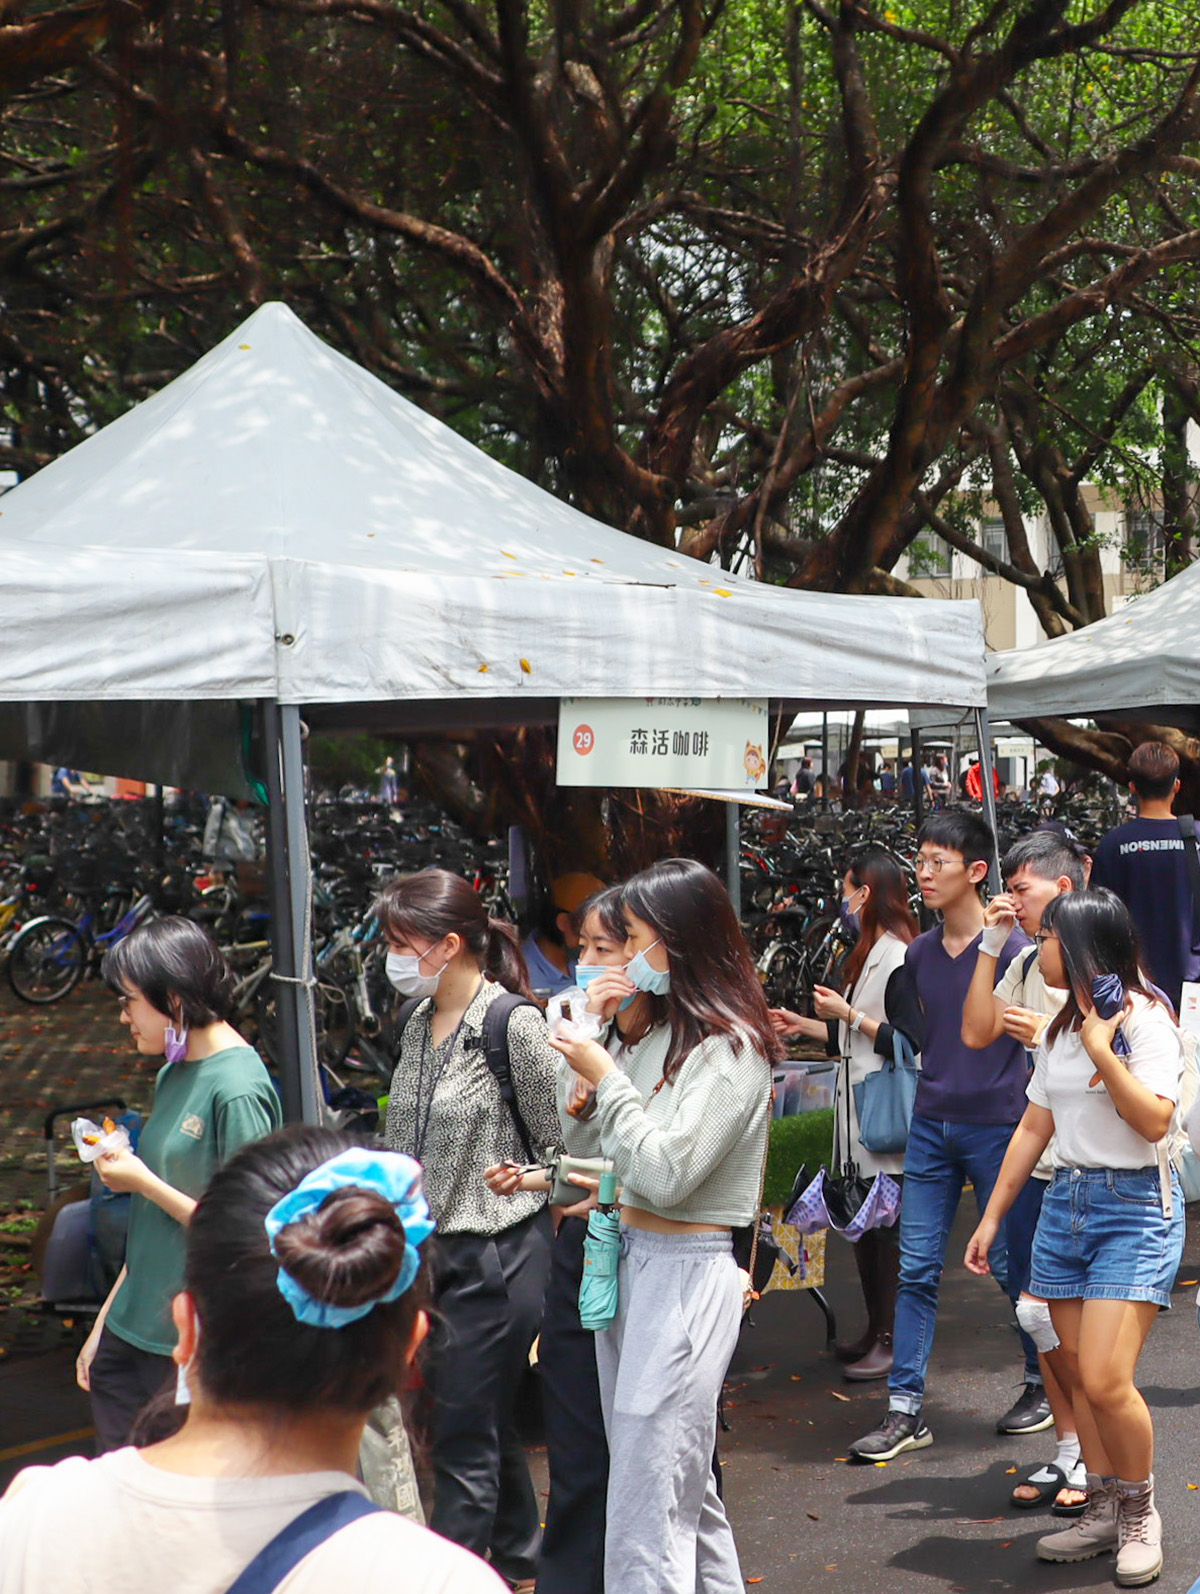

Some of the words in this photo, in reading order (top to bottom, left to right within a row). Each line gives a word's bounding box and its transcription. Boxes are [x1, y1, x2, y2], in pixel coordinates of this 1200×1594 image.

[575, 731, 592, 749] 29
[629, 728, 710, 757] 森活咖啡
